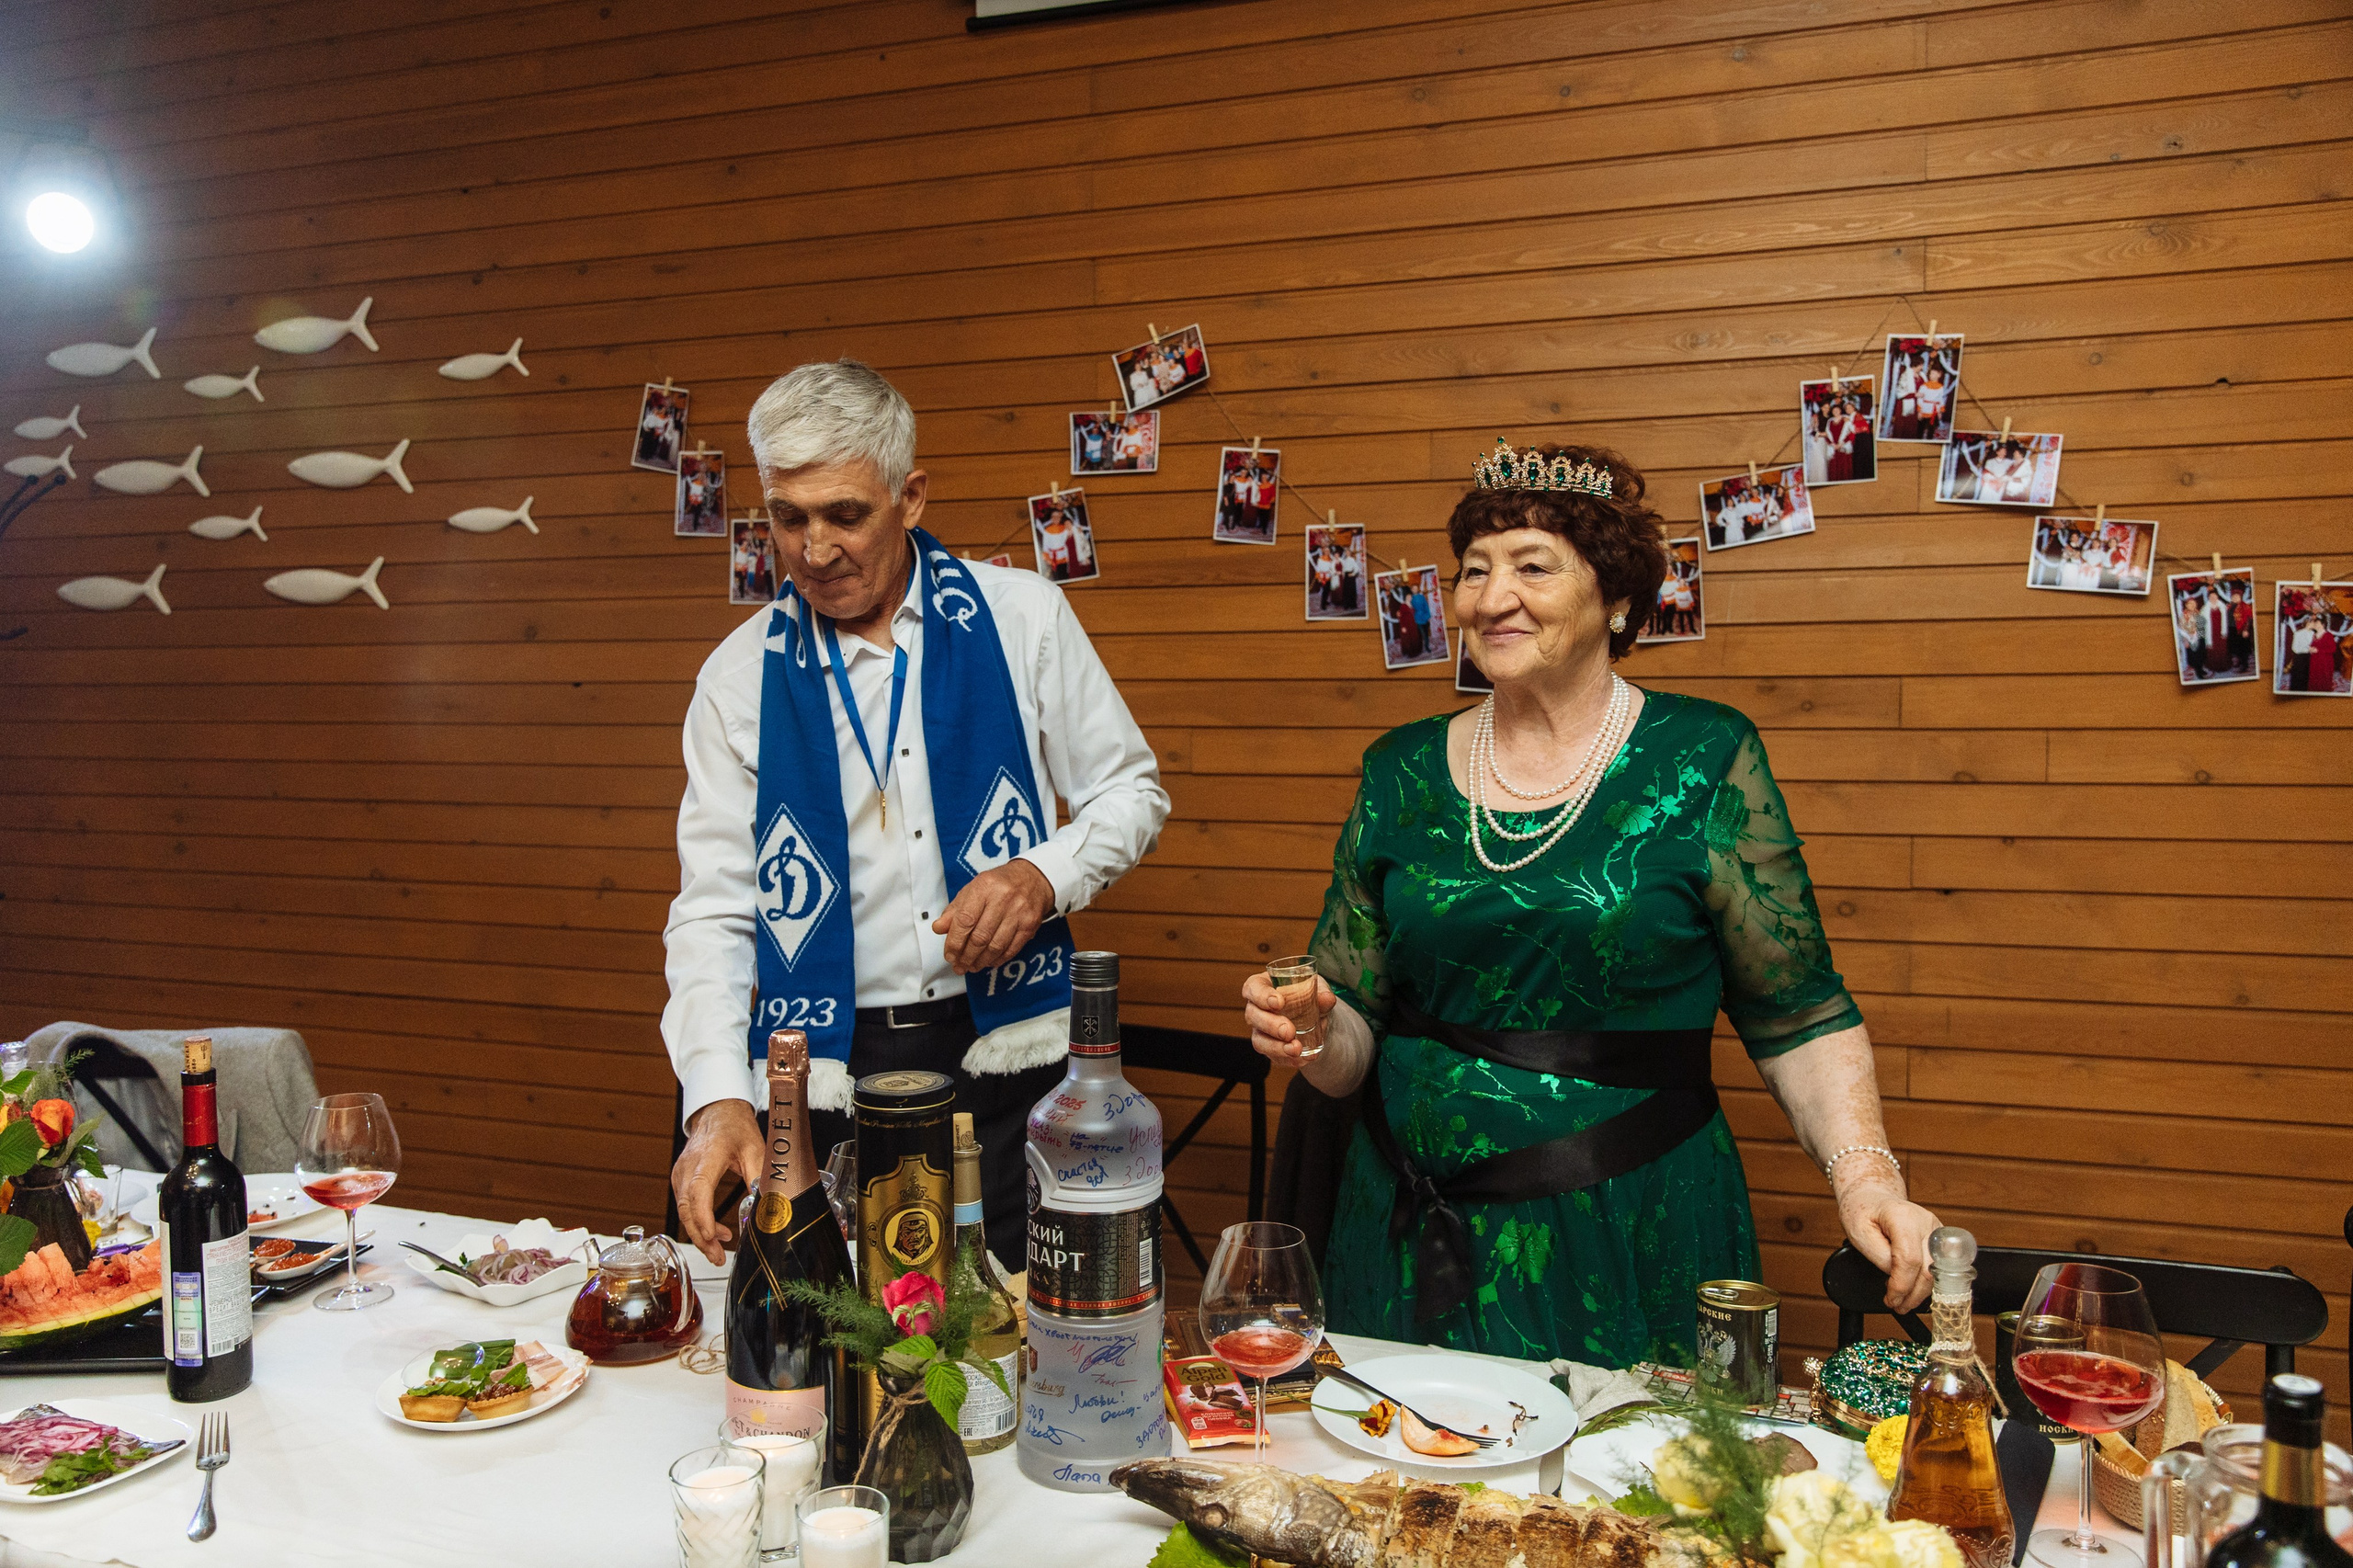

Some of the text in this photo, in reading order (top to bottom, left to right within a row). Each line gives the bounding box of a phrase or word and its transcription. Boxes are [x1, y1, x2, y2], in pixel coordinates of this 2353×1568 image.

[985, 946, 1063, 997] 1923
[756, 996, 838, 1028] 1923
[769, 1095, 793, 1183] MOËT
[1181, 1365, 1228, 1376] Alpen
[1187, 1370, 1228, 1382] Gold
[963, 1427, 973, 1437] EAC
